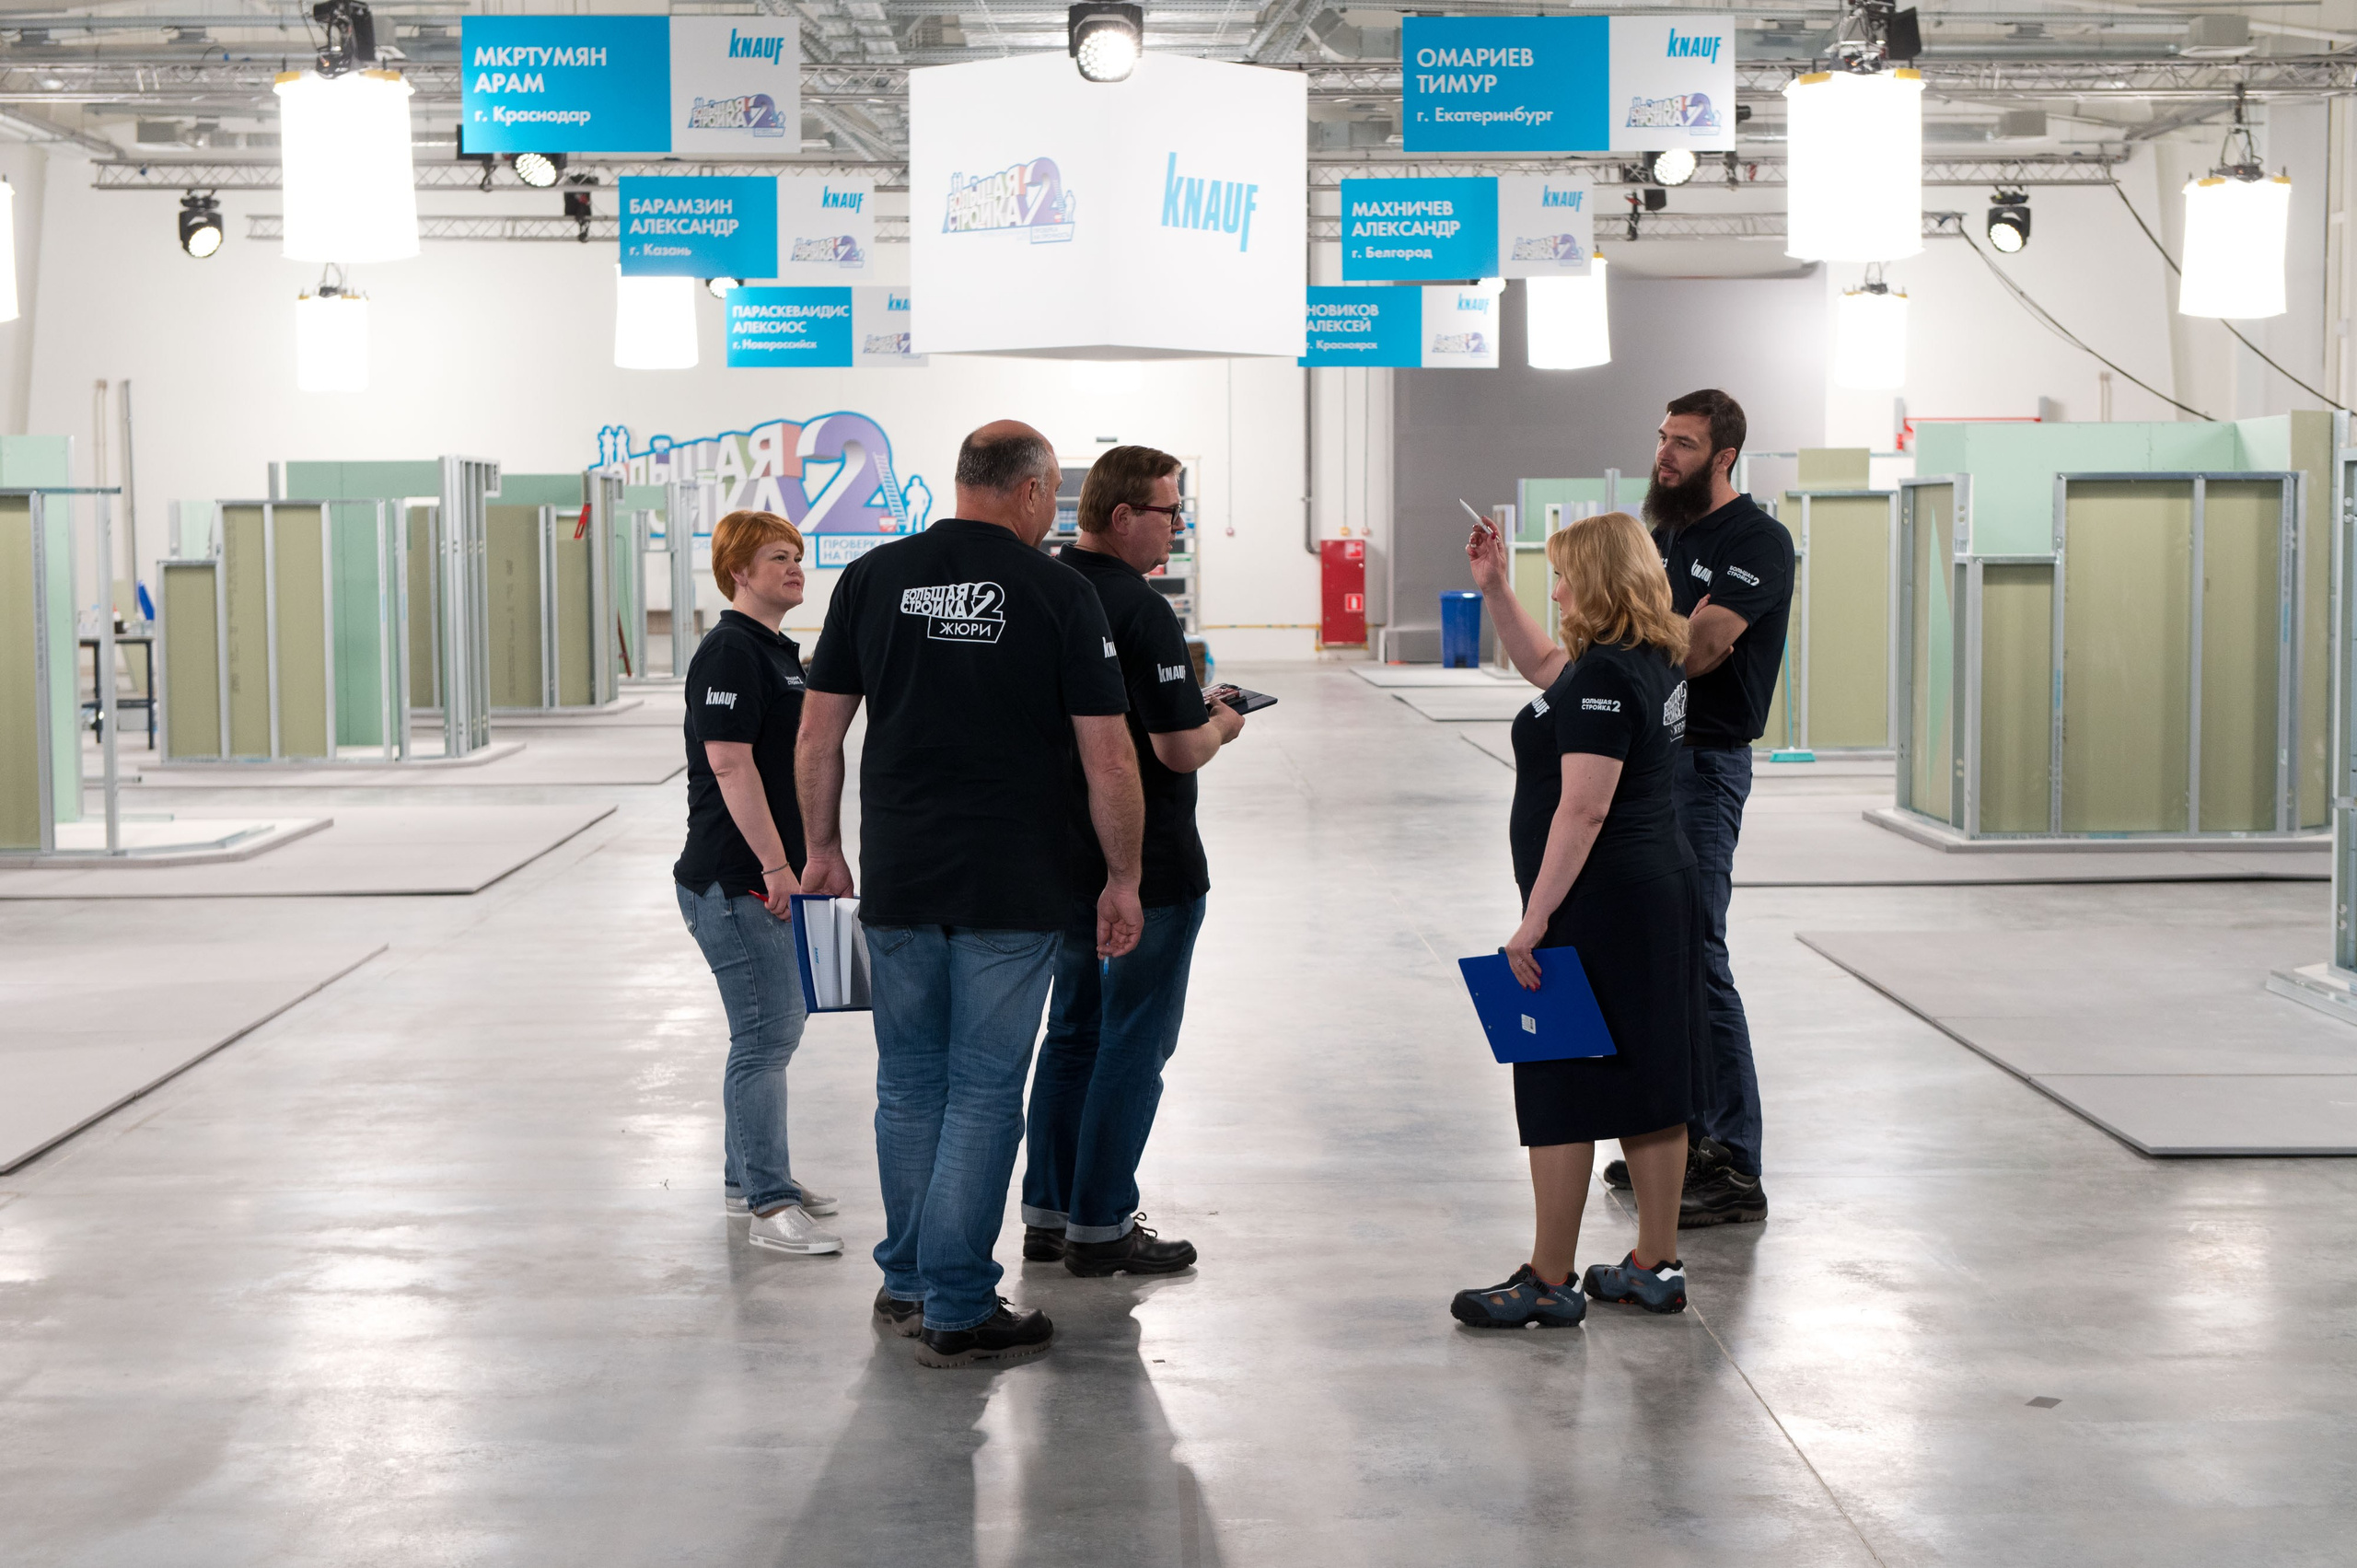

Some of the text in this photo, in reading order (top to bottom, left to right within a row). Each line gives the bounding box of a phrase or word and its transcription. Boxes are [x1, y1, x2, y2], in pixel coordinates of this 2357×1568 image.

[728, 28, 784, 65] KNAUF
[1666, 28, 1722, 64] KNAUF
[473, 46, 608, 67] МКРТУМЯН
[1416, 48, 1535, 67] ОМАРИЕВ
[473, 72, 545, 93] АРАМ
[1416, 74, 1498, 93] ТИМУР
[474, 105, 591, 126] г. Краснодар
[1417, 105, 1553, 126] г. Екатеринбург
[629, 198, 733, 215] БАРАМЗИН
[821, 185, 865, 214] KNAUF
[1161, 151, 1259, 252] KNAUF
[1541, 184, 1584, 213] KNAUF
[1352, 201, 1454, 217] МАХНИЧЕВ
[629, 218, 739, 238] АЛЕКСАНДР
[1351, 220, 1461, 238] АЛЕКСАНДР
[643, 243, 692, 256] Казань
[1352, 246, 1433, 261] г. Белгород
[888, 293, 911, 311] KNA
[1306, 304, 1379, 317] НОВИКОВ
[732, 305, 850, 319] ПАРАСКЕВАИДИС
[732, 320, 807, 333] АЛЕКСИОС
[1306, 317, 1372, 332] АЛЕКСЕЙ
[603, 419, 783, 486] ОЛЬШАЯ
[796, 412, 892, 533] 2
[902, 582, 1005, 620] БОЛЬШАЯ 2
[939, 622, 992, 637] ЖЮРИ
[705, 686, 737, 710] KNAUF
[1581, 703, 1611, 712] СТРОЙКА
[1611, 700, 1621, 713] 2
